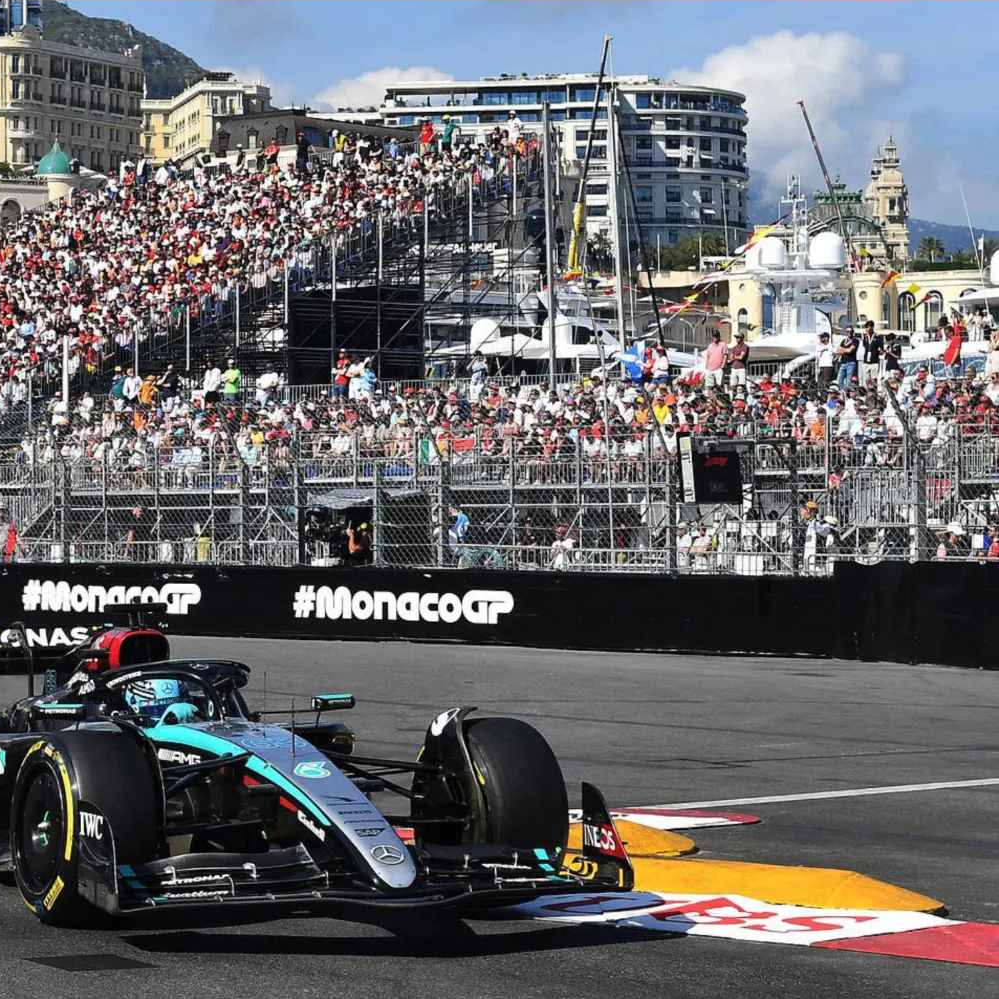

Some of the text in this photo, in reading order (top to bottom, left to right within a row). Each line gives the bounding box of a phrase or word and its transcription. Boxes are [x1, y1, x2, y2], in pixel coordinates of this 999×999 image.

[22, 580, 202, 614] #MonacoGP
[293, 585, 515, 624] #MonacoGP
[173, 753, 200, 765] AMG
[79, 811, 104, 840] IWC
[583, 823, 616, 851] INEOS
